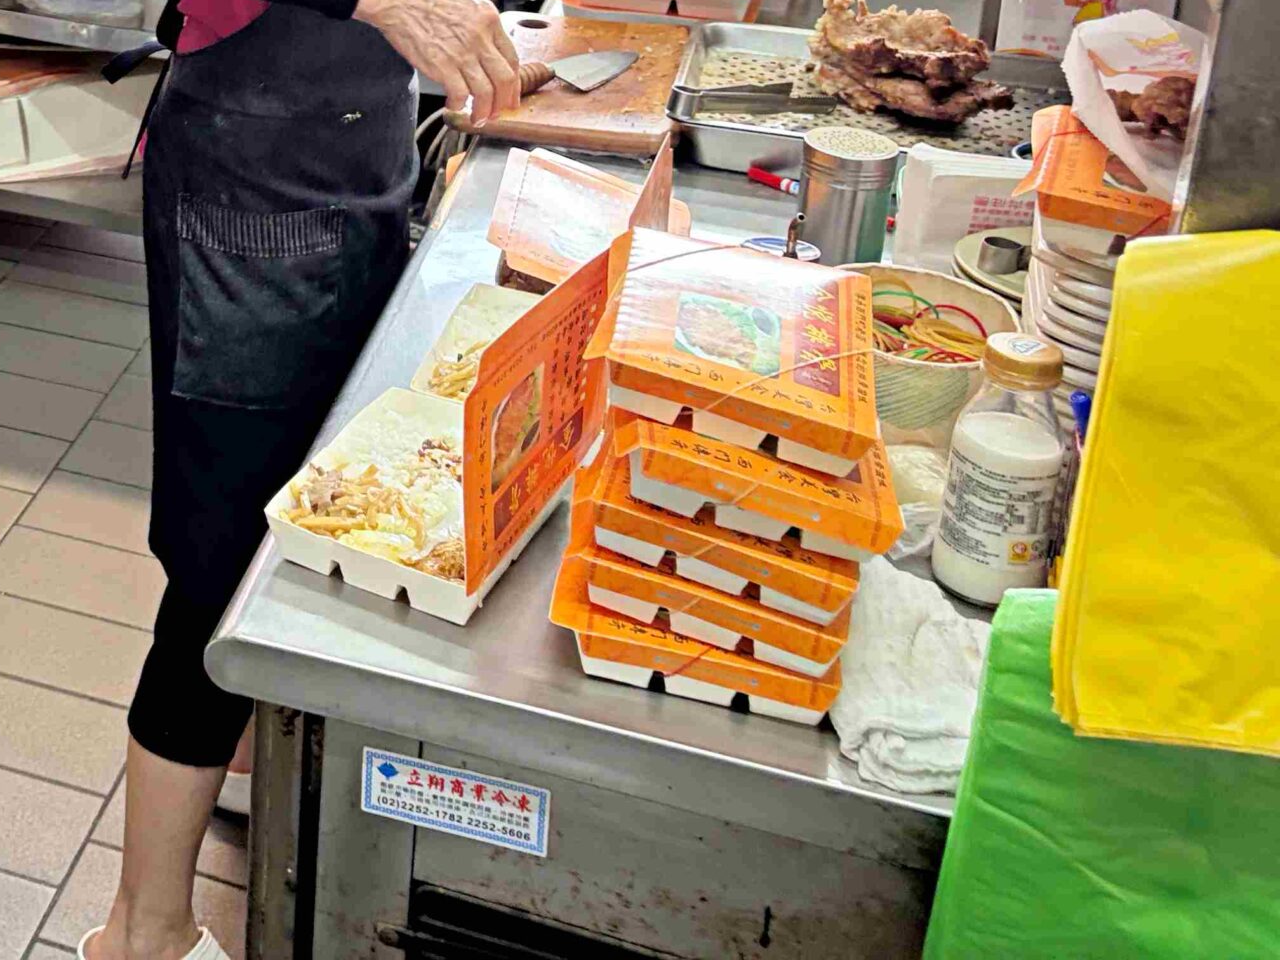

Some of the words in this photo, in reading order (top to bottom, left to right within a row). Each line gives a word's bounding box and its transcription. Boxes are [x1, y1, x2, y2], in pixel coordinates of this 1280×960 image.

[406, 768, 533, 814] 立翔商業冷凍
[376, 794, 464, 824] (02)2252-1782
[467, 816, 531, 842] 2252-5606
